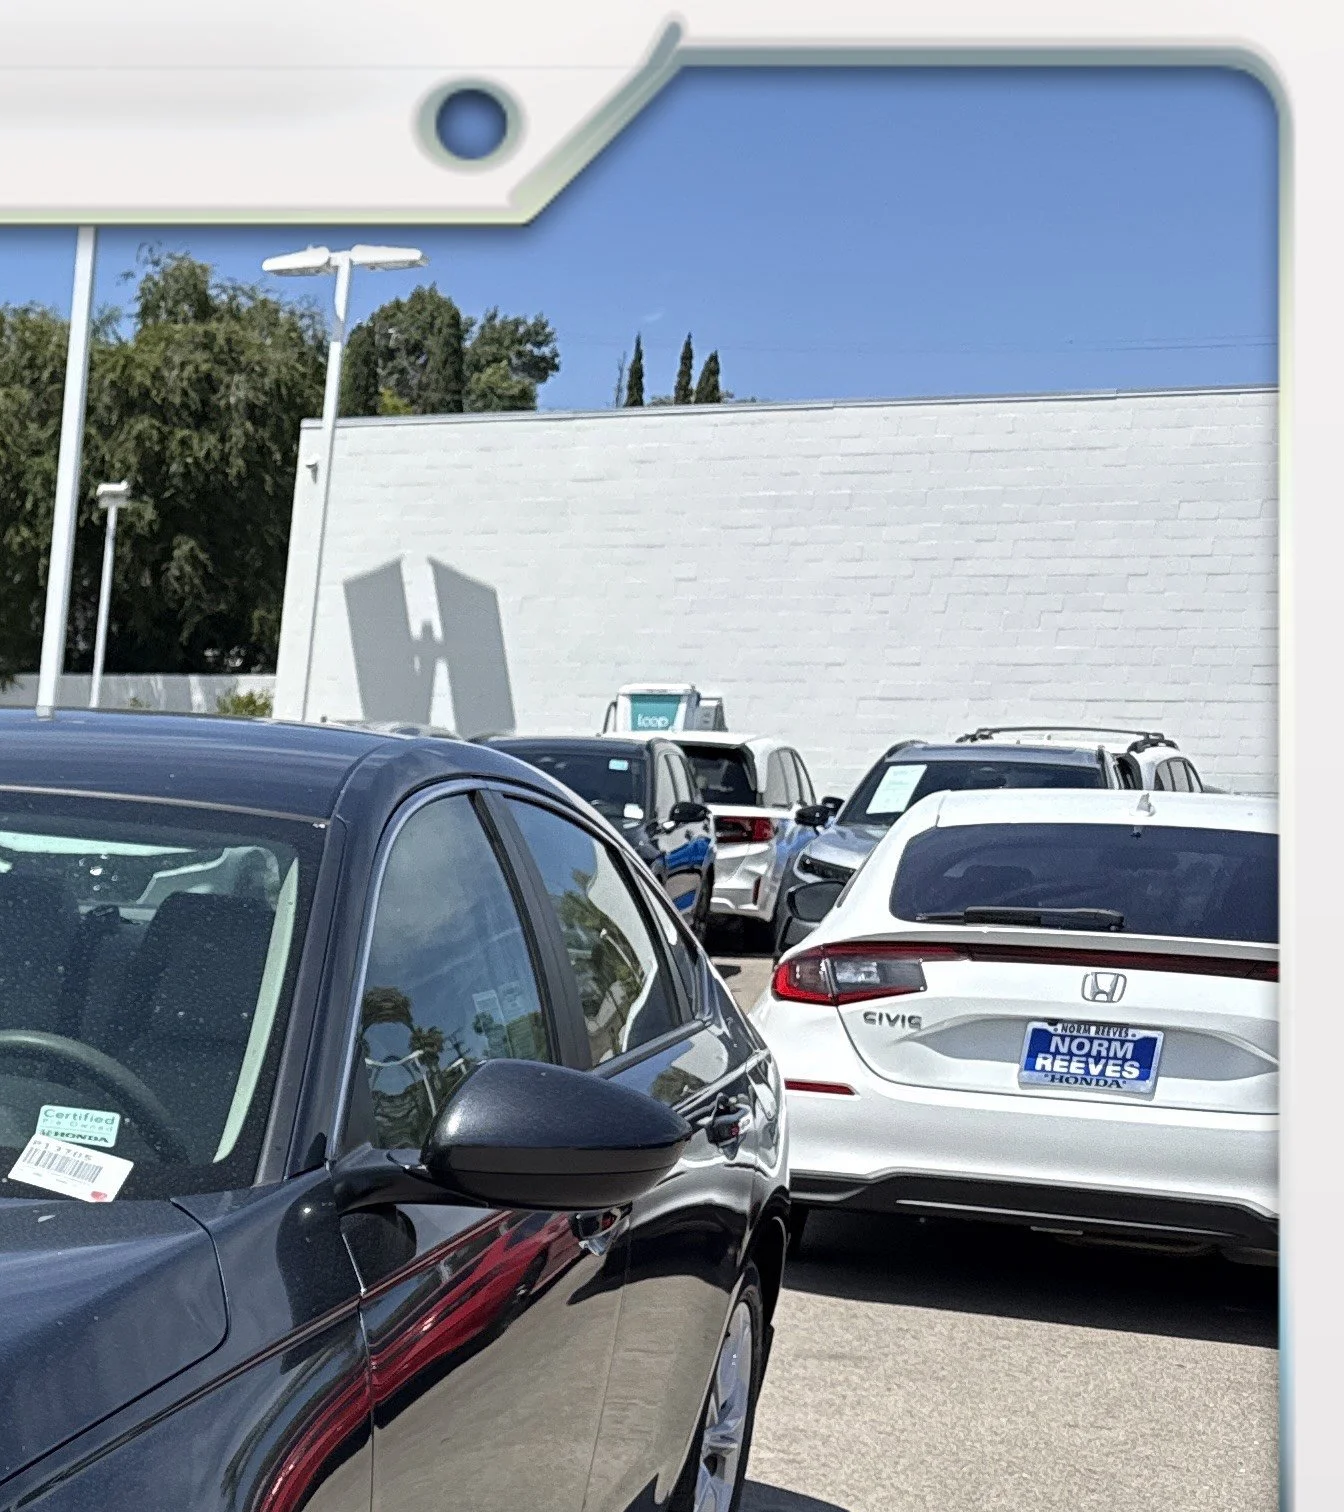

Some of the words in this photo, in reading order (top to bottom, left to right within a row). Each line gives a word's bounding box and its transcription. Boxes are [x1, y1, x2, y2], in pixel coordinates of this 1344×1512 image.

[863, 1011, 922, 1029] CIVIC
[1049, 1035, 1134, 1060] NORM
[1035, 1053, 1140, 1079] REEVES
[1048, 1074, 1123, 1088] HONDA
[44, 1108, 115, 1125] Certified
[53, 1131, 109, 1144] HONDA
